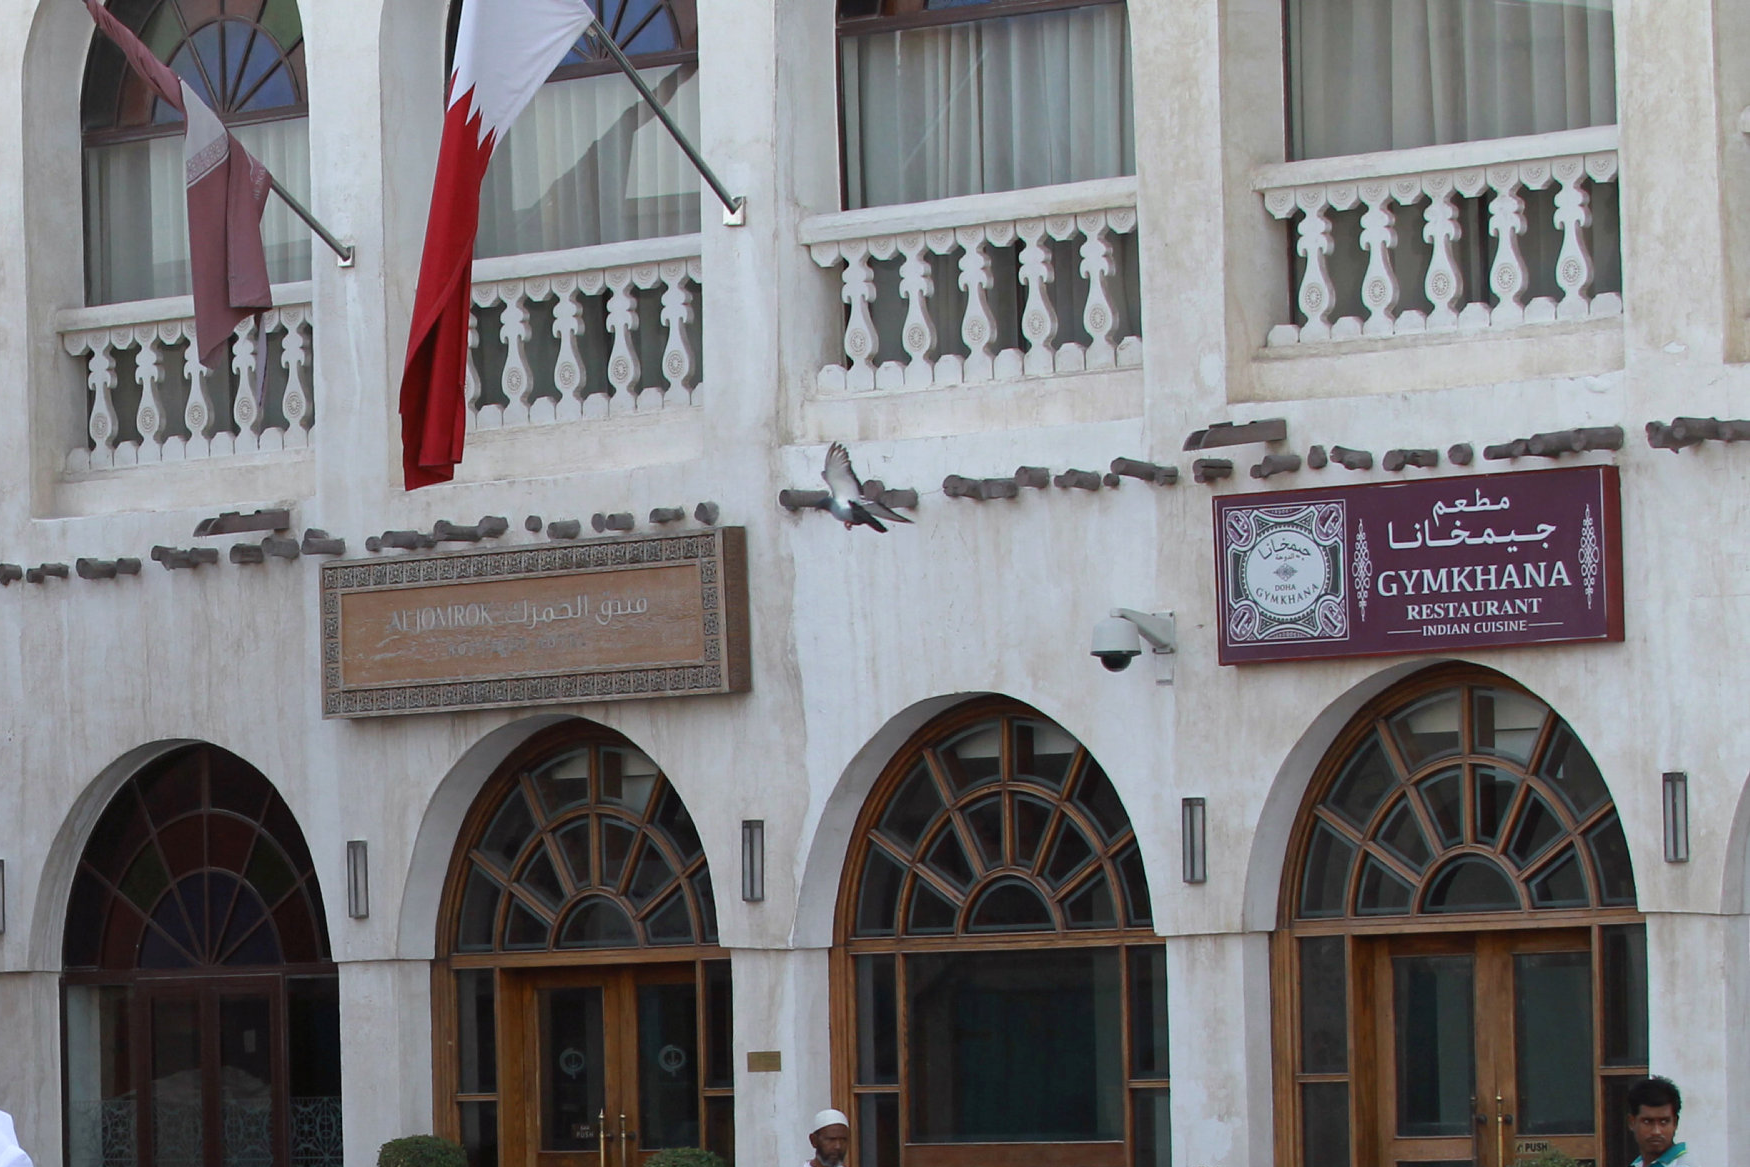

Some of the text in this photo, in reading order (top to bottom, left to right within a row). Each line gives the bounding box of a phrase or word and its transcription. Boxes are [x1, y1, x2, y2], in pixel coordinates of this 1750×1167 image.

[1432, 488, 1510, 527] مطعم
[1387, 519, 1557, 553] جيمخانا
[1274, 583, 1296, 592] DOHA
[1377, 560, 1572, 597] GYMKHANA
[1256, 583, 1319, 605] GYMKHANA
[1406, 597, 1542, 620] RESTAURANT
[1422, 619, 1528, 637] INDIAN CUISINE
[1524, 1142, 1548, 1153] PUSH
